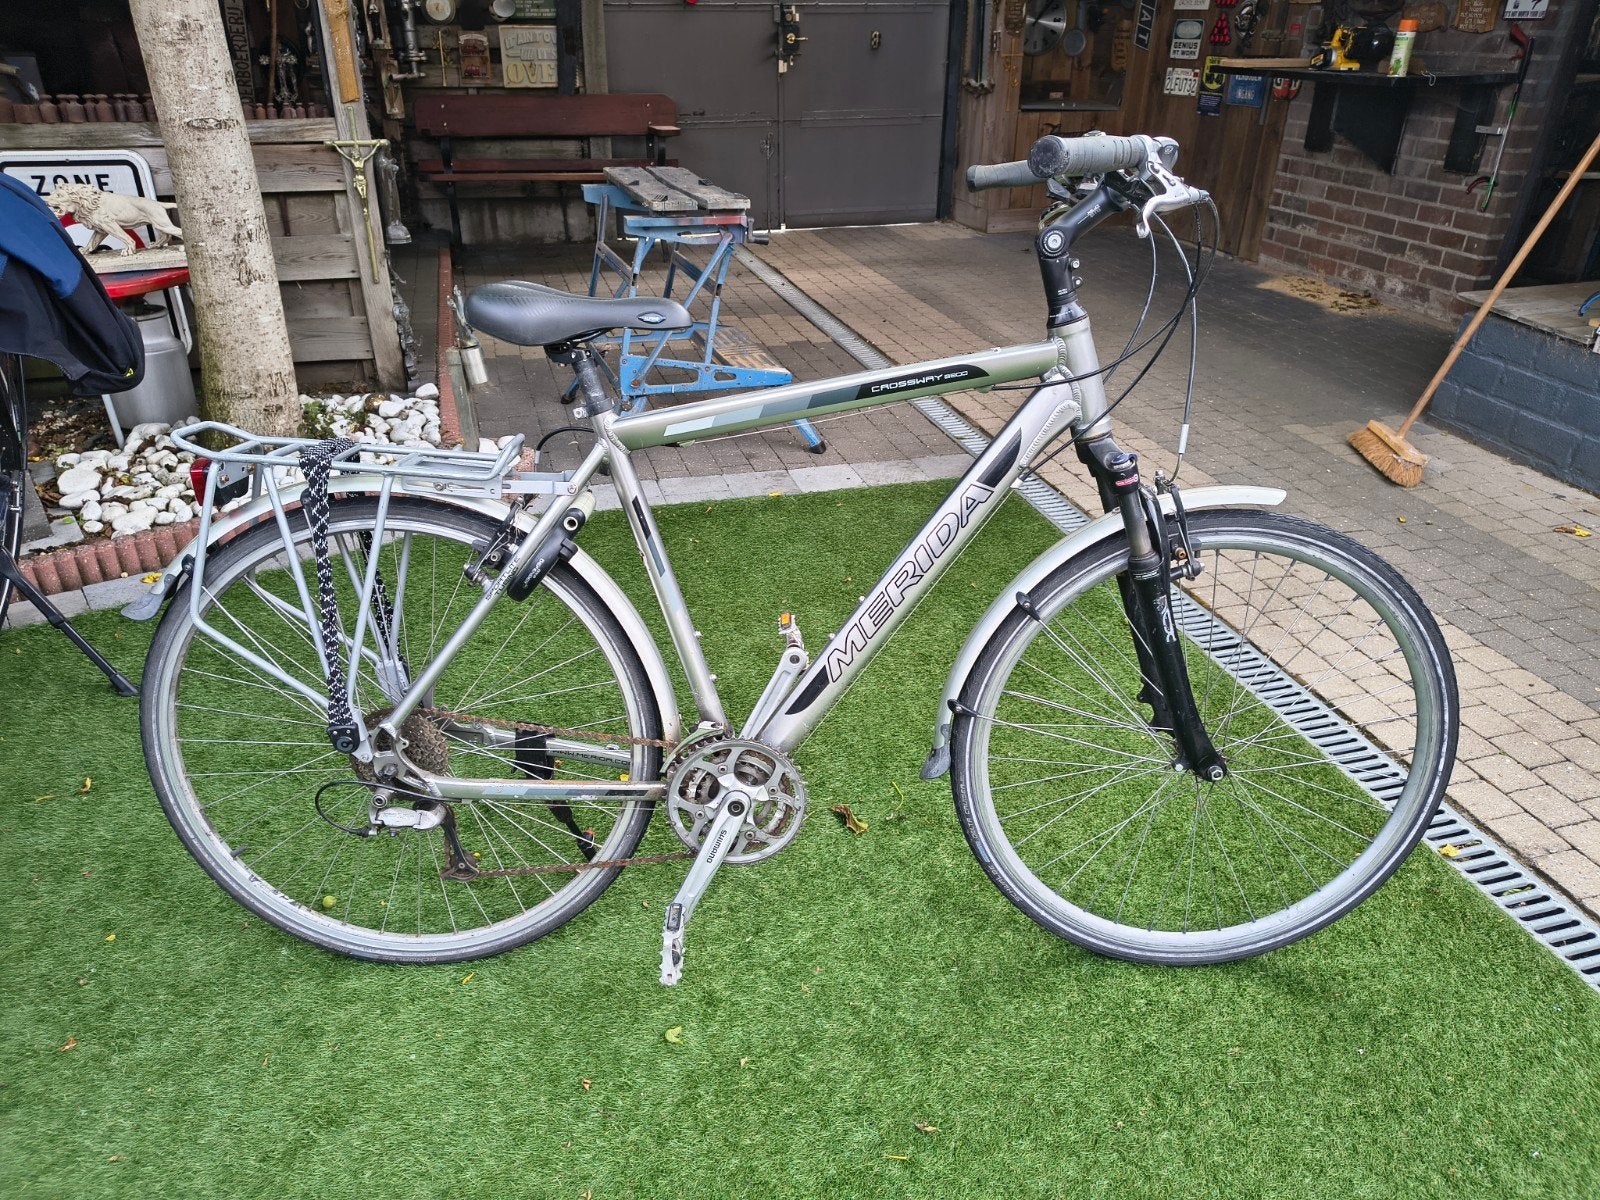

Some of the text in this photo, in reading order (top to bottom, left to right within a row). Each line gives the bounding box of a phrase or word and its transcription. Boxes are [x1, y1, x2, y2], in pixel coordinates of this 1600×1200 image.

[871, 373, 943, 393] CROSSWAY
[827, 483, 994, 684] MERIDA
[706, 829, 728, 864] SHIMANO
